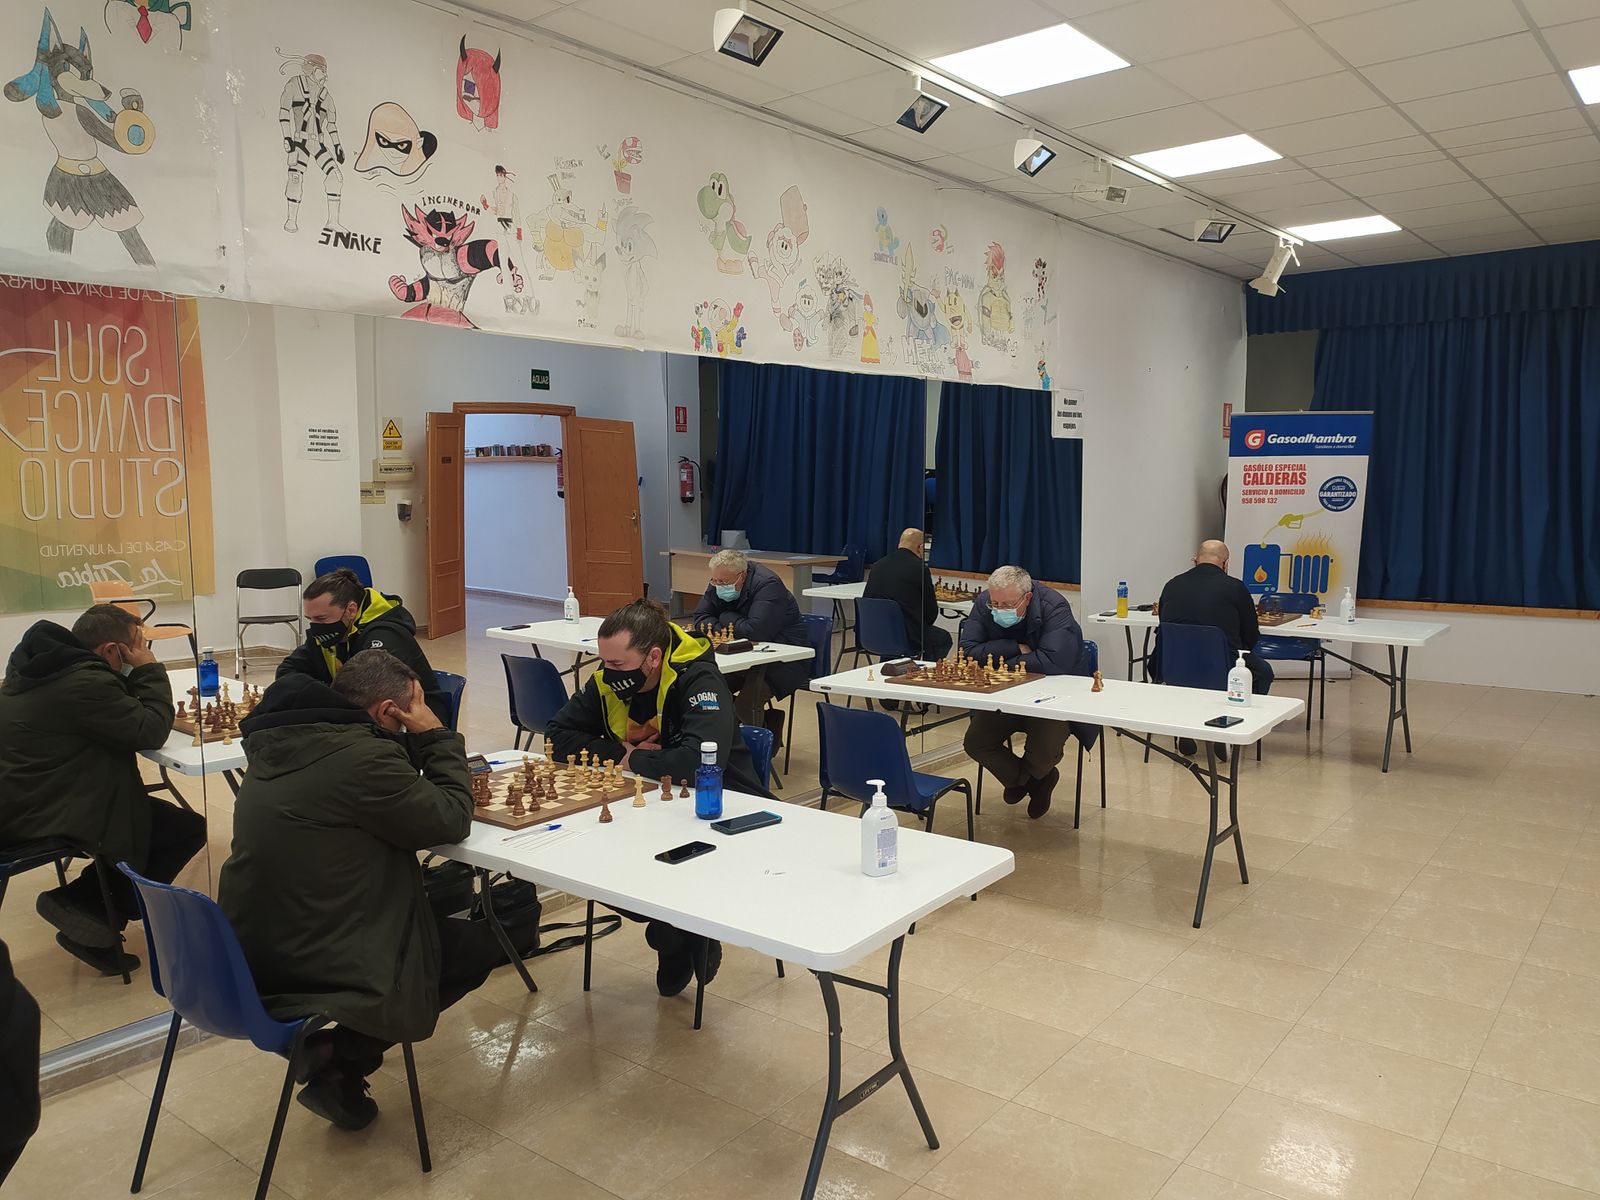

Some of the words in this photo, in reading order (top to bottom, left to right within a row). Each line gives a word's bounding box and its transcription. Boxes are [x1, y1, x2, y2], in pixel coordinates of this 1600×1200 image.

[421, 195, 481, 216] INCINEROAR
[318, 227, 382, 255] SNAKE
[1267, 433, 1357, 444] Gasoalhambra
[1243, 463, 1274, 472] GASÓLEO
[1274, 463, 1307, 471] ESPECIAL
[1243, 472, 1307, 486] CALDERAS
[1241, 488, 1269, 496] SERVICIO
[688, 691, 719, 707] SLOGAN
